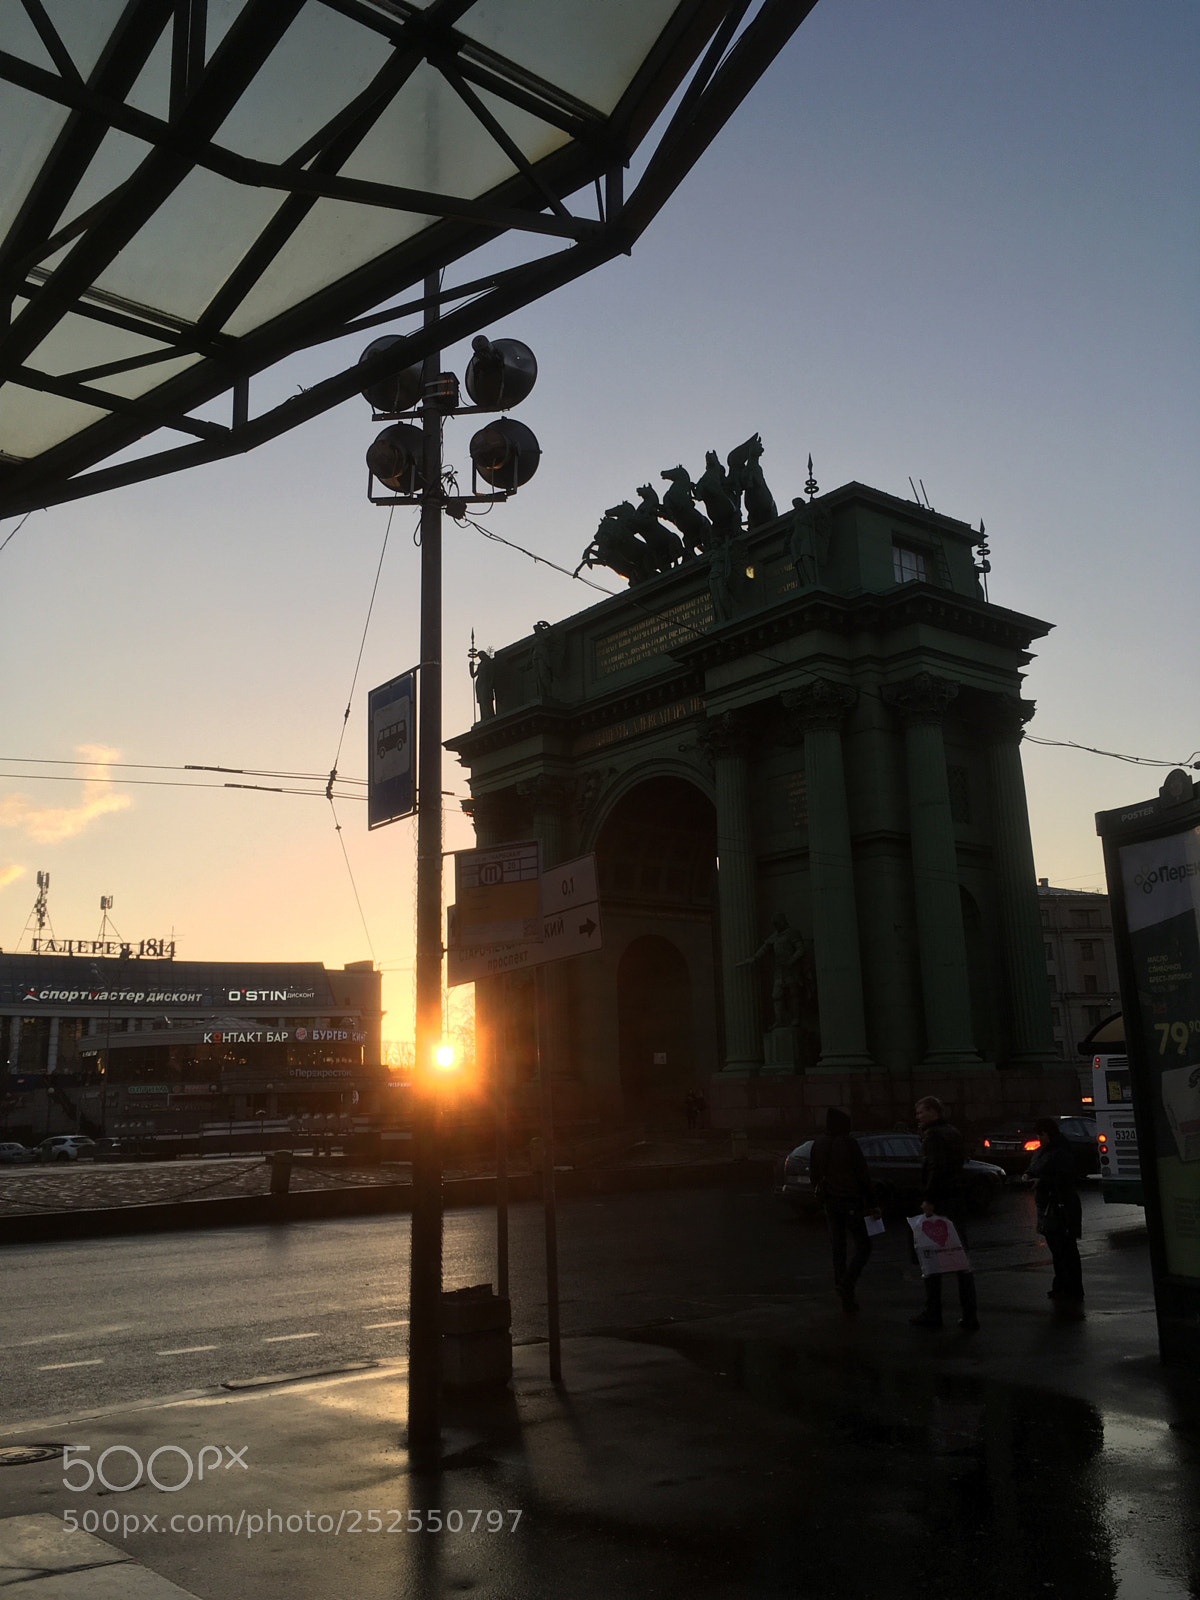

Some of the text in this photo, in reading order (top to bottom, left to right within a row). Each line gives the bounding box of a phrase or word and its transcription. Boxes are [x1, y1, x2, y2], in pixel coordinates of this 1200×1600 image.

[1121, 806, 1155, 822] POSTER
[32, 937, 177, 958] ГАЛЕРЕЯ 1814
[487, 950, 529, 972] проспект
[39, 990, 203, 1003] спортмастер дисконт
[203, 1031, 289, 1044] КОНТАКТ БАР
[312, 1029, 348, 1041] БУРГЕР
[1153, 1021, 1189, 1056] 79
